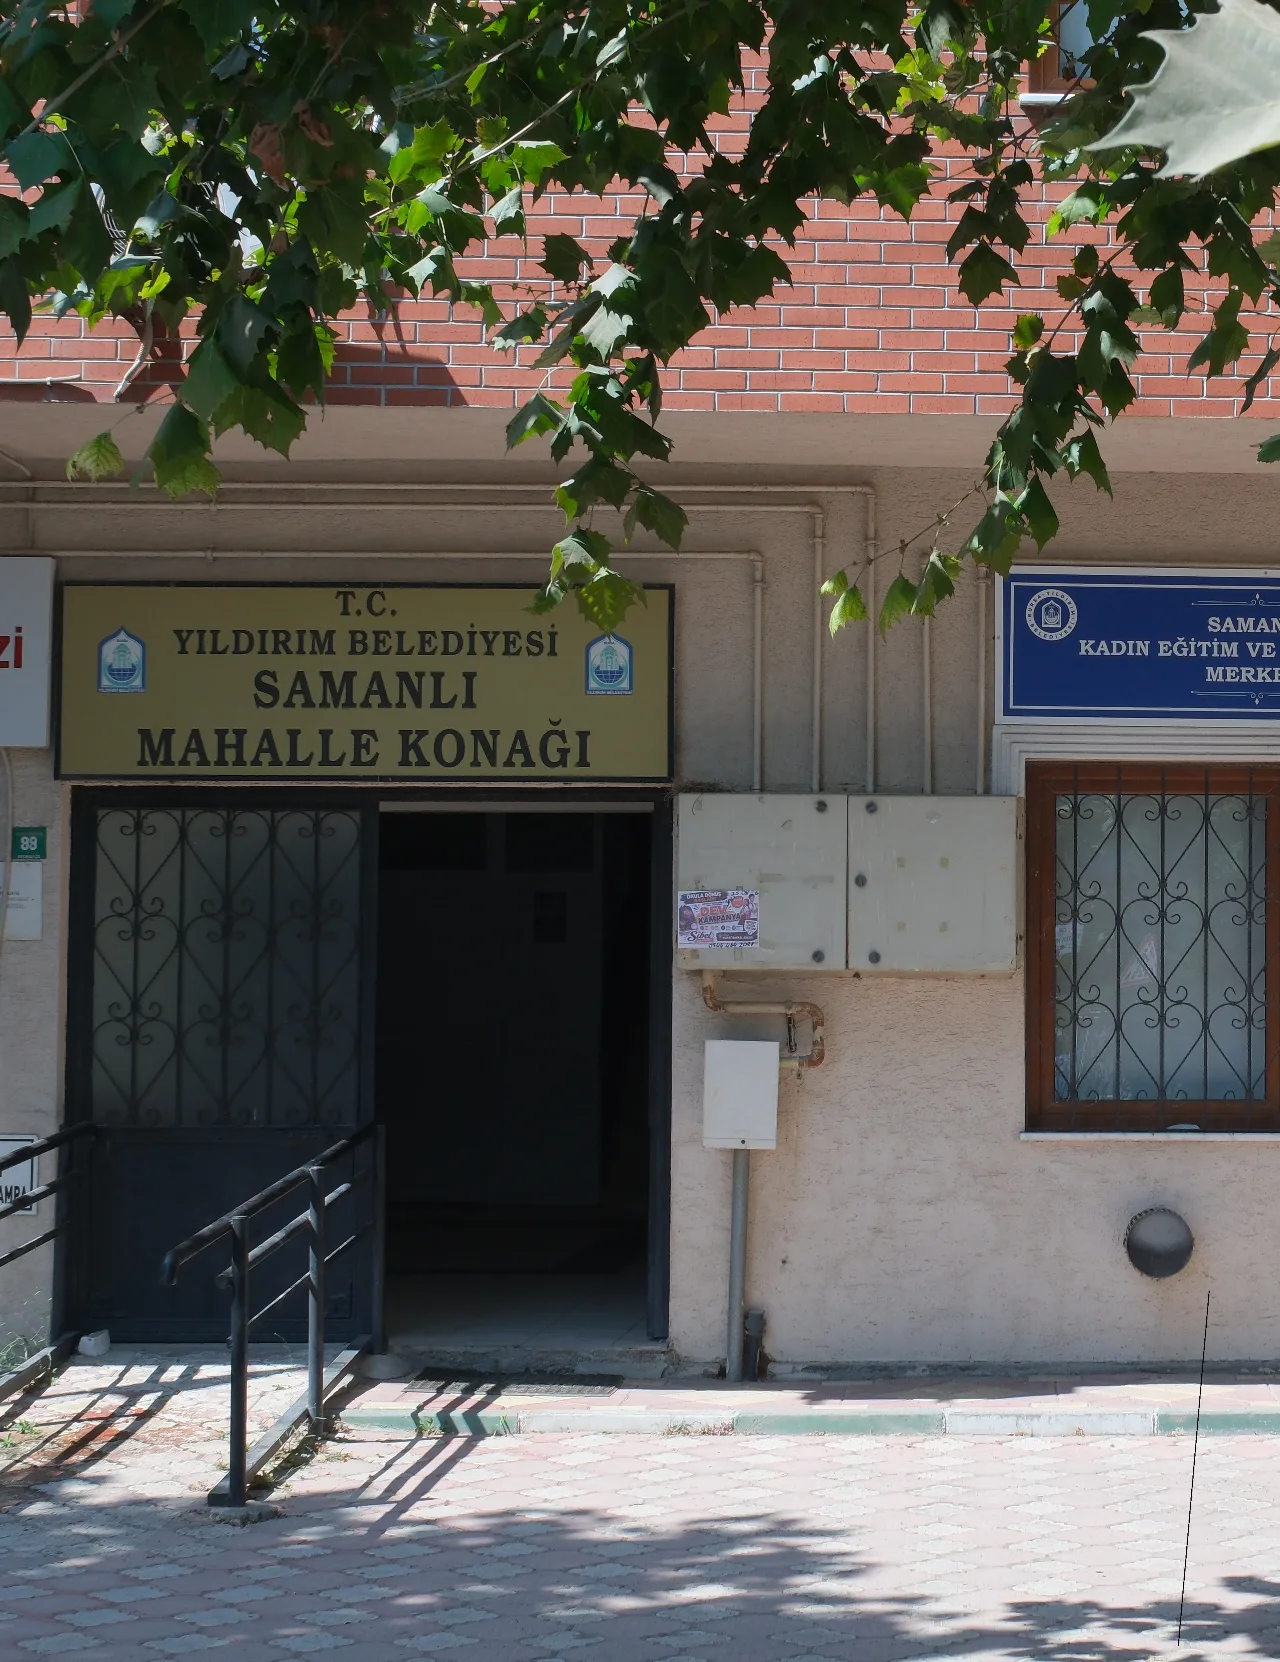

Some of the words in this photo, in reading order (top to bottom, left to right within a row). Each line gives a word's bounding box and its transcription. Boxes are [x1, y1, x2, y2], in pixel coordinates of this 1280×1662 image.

[335, 590, 397, 617] T.C.
[173, 629, 336, 656] YILDIRIM
[348, 623, 558, 657] BELEDİYESİ
[1079, 639, 1150, 657] KADIN
[1158, 637, 1239, 658] EĞİTİM
[1246, 642, 1276, 658] VE
[253, 669, 478, 710] SAMANLI
[137, 728, 380, 767] MAHALLE
[398, 718, 591, 769] KONAĞI
[698, 913, 741, 924] KAMPANYA
